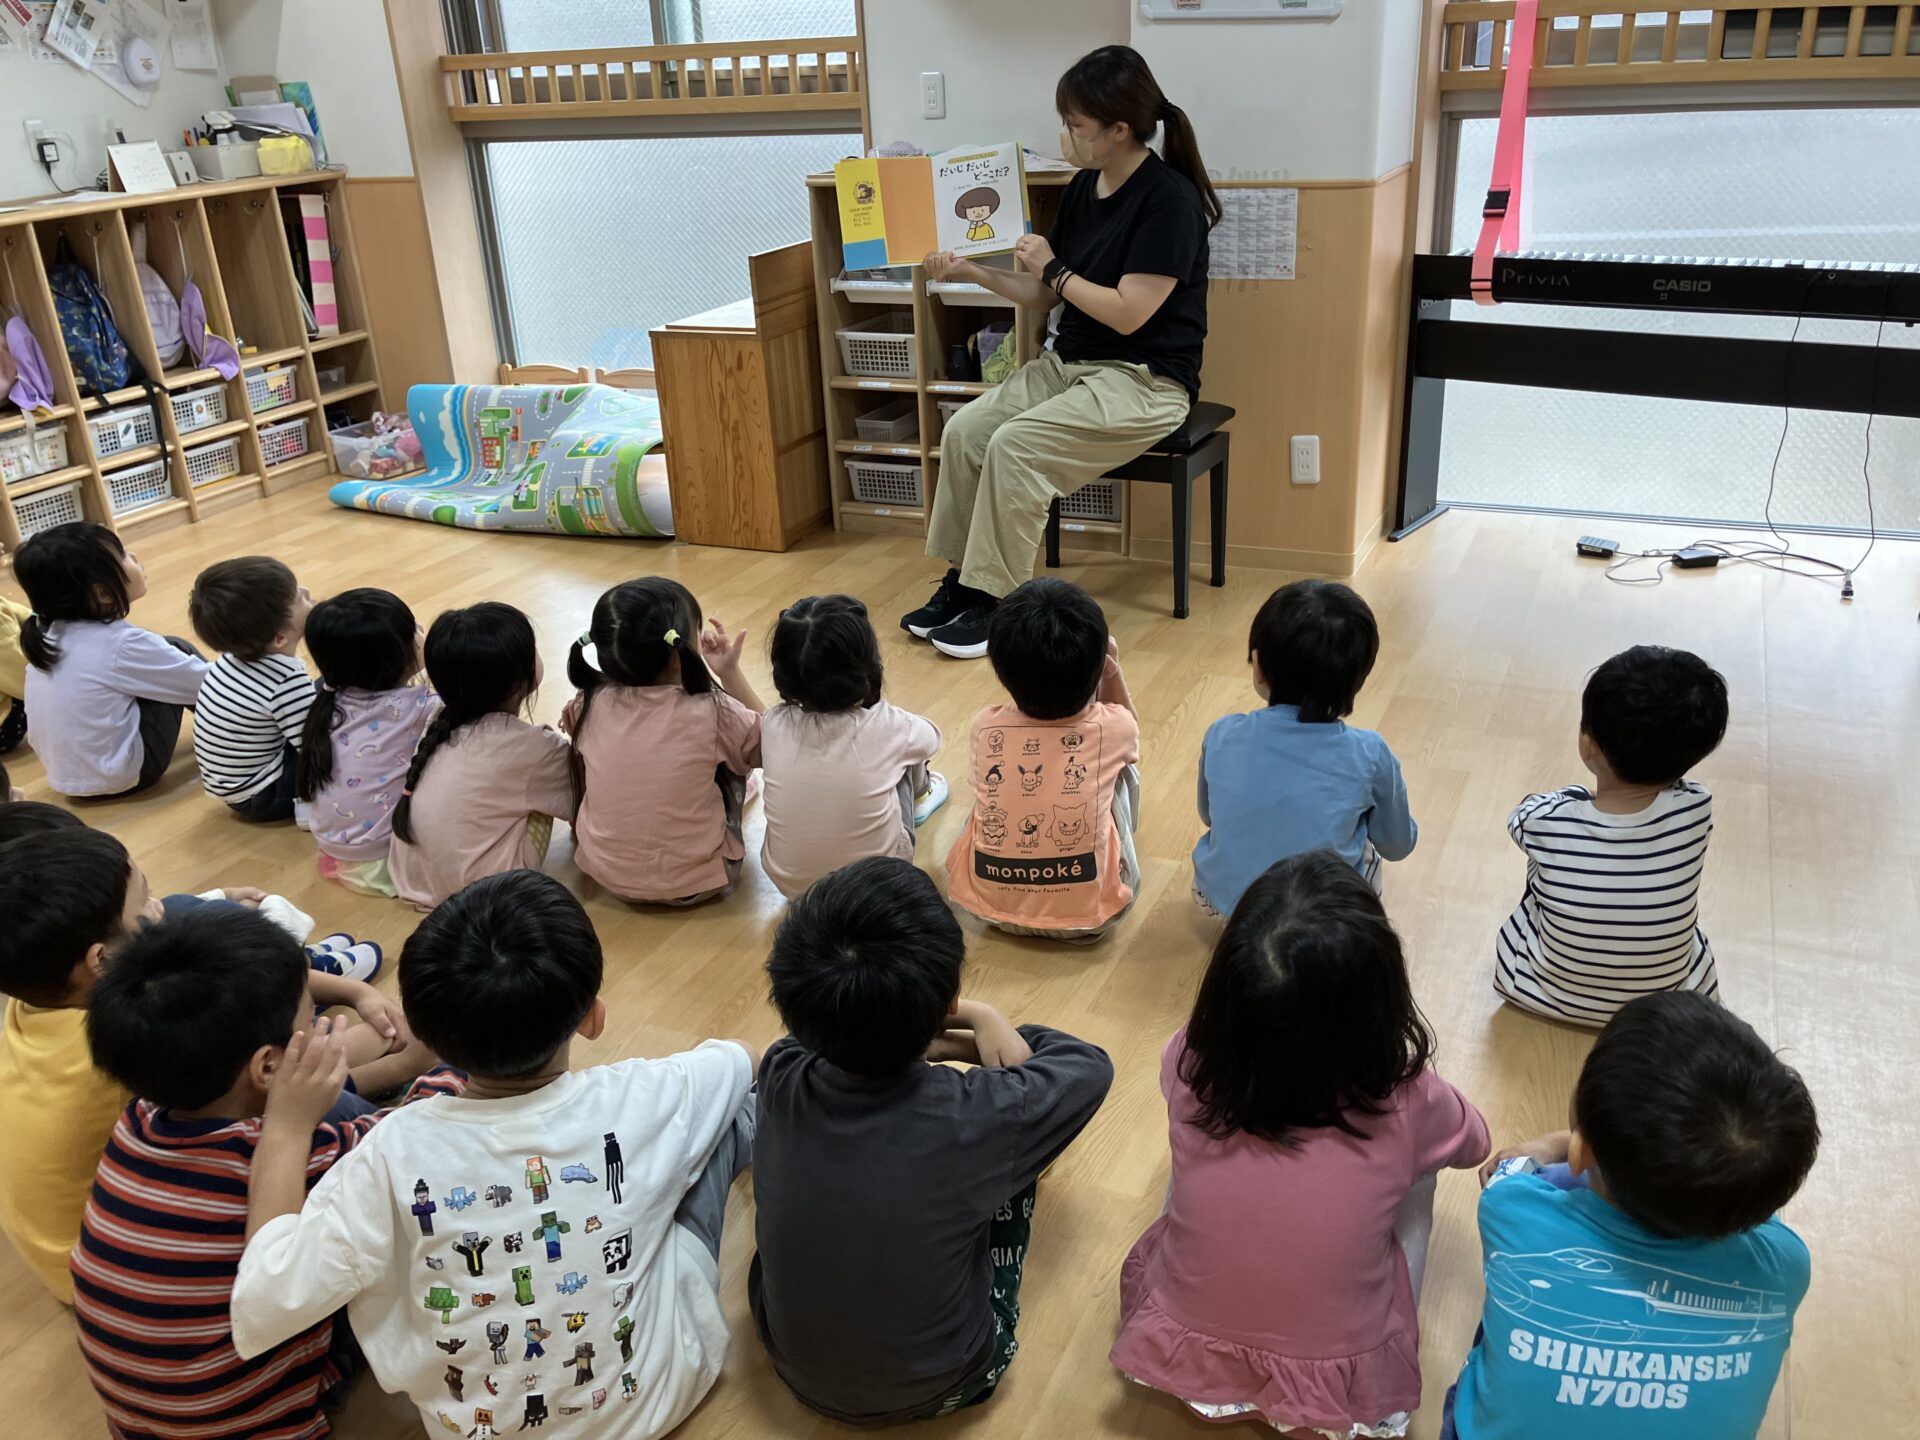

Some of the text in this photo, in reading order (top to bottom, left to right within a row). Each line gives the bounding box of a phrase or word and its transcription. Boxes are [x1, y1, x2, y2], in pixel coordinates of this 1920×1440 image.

[1652, 278, 1712, 293] CASIO
[985, 860, 1082, 881] monpoké
[1509, 1328, 1752, 1382] SHINKANSEN
[1556, 1375, 1689, 1409] N700S
